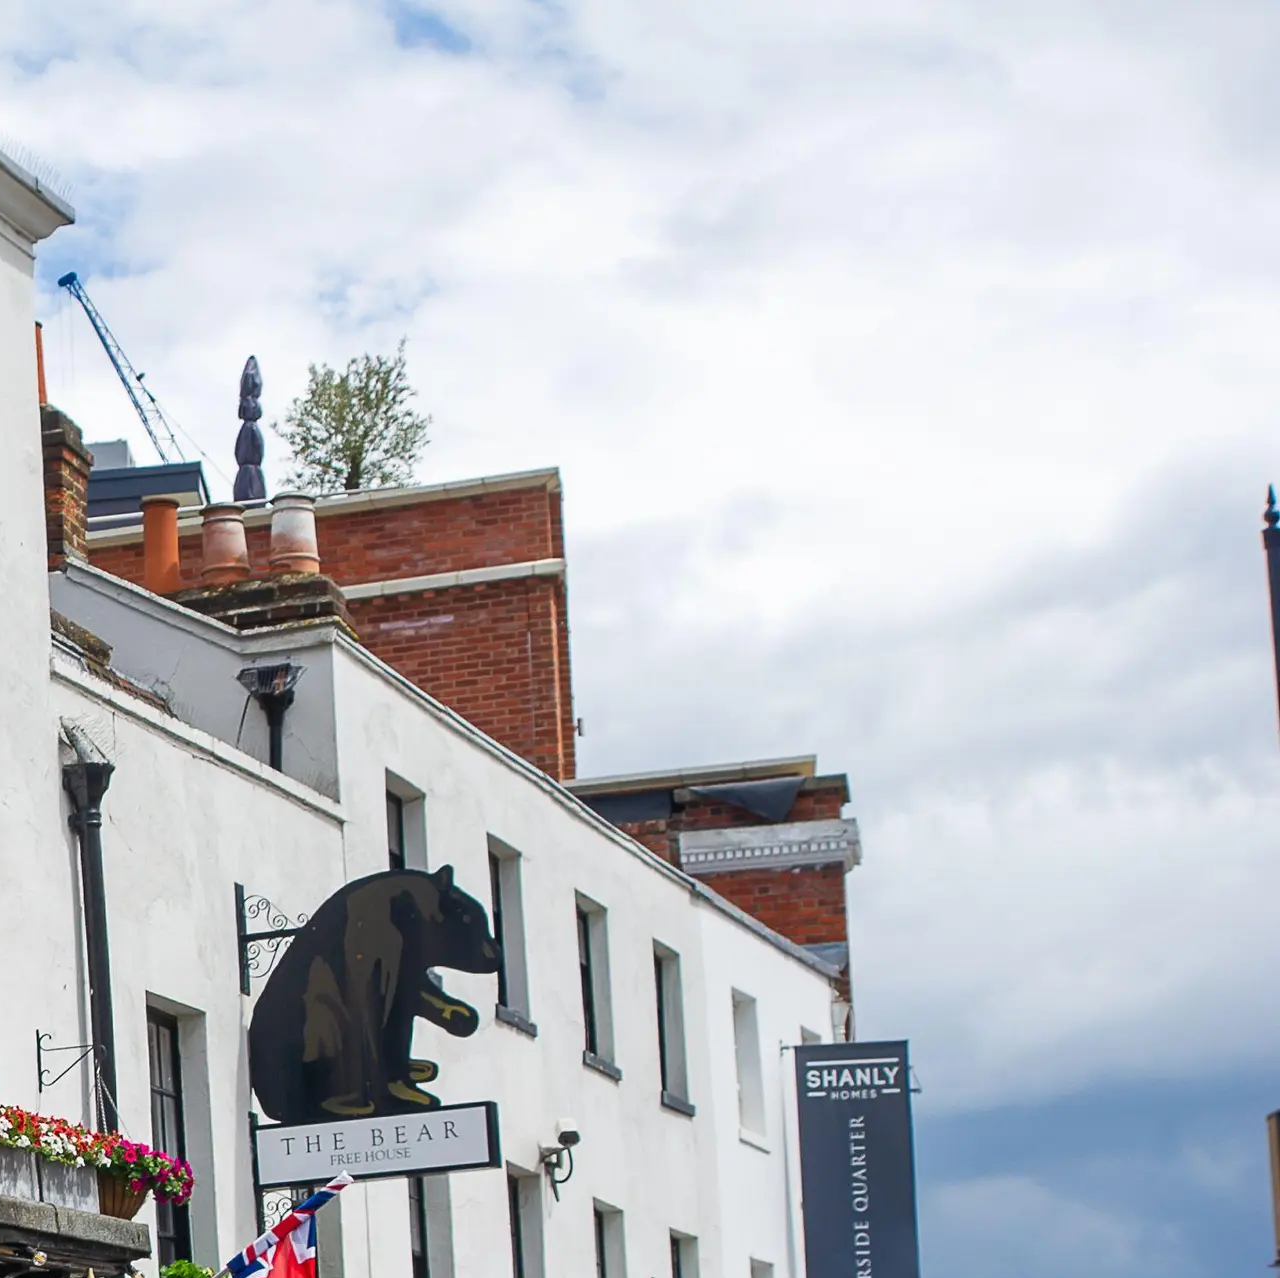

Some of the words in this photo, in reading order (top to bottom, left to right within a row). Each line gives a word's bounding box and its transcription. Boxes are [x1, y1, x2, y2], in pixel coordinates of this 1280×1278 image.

[805, 1066, 899, 1089] SHANLY
[830, 1088, 878, 1100] HOMES
[281, 1132, 346, 1156] THE
[371, 1120, 459, 1148] BEAR
[330, 1151, 362, 1166] FREE
[365, 1147, 411, 1162] HOUSE
[849, 1115, 870, 1211] QUARTER
